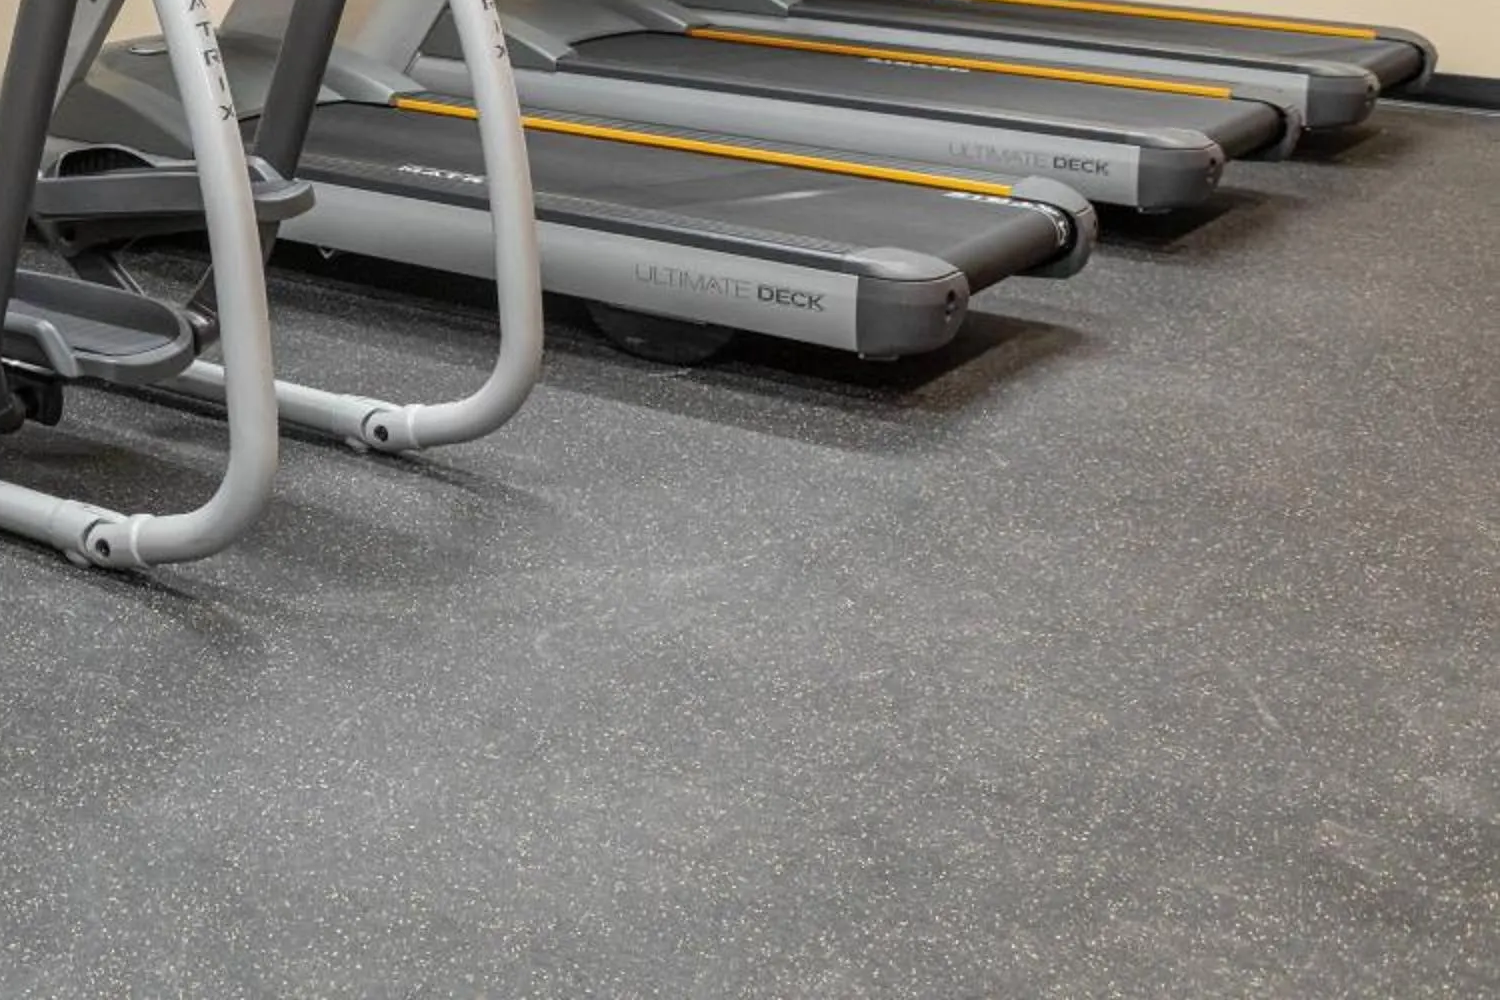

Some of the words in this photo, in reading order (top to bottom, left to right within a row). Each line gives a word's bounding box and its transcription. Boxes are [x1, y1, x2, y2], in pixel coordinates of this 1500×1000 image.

[1053, 155, 1109, 176] DECK
[634, 263, 749, 299] ULTIMATE
[757, 284, 826, 312] DECK
